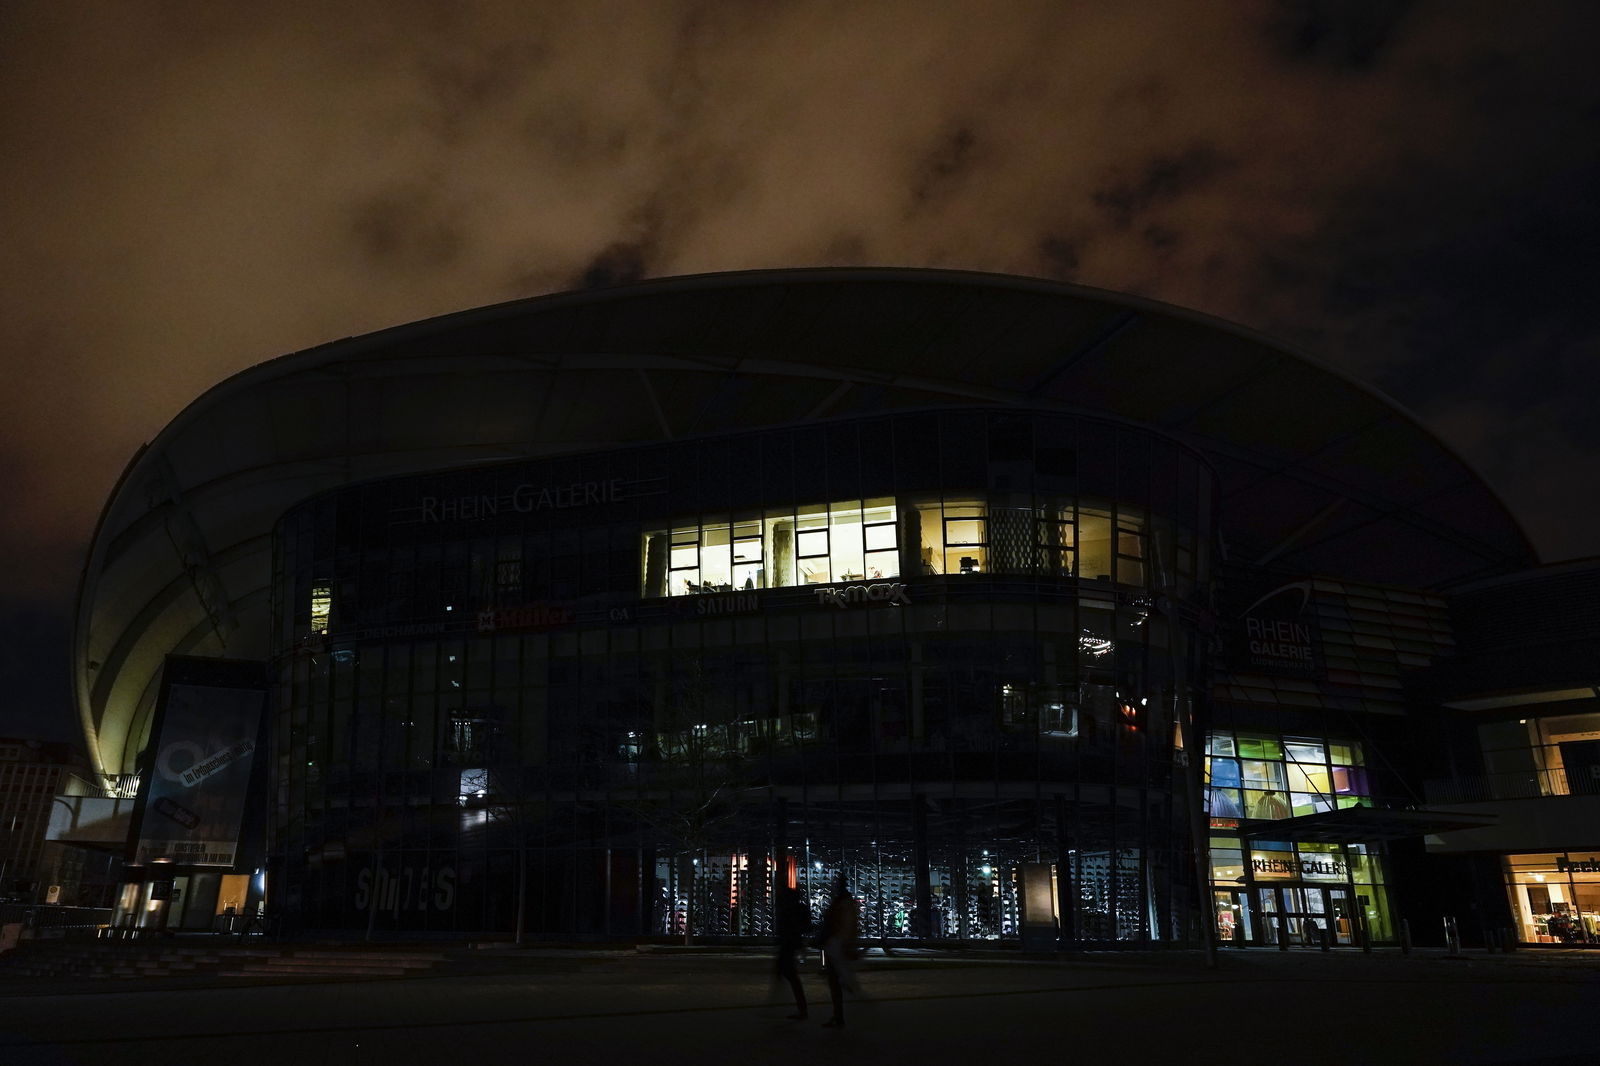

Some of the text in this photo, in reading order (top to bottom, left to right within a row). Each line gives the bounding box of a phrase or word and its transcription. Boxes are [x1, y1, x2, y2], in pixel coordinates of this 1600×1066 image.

[421, 478, 625, 524] RHEIN GALERIE
[697, 594, 759, 615] SATURN
[1246, 617, 1311, 645] RHEIN
[1250, 640, 1313, 660] GALERIE
[1253, 858, 1296, 874] RHEIN
